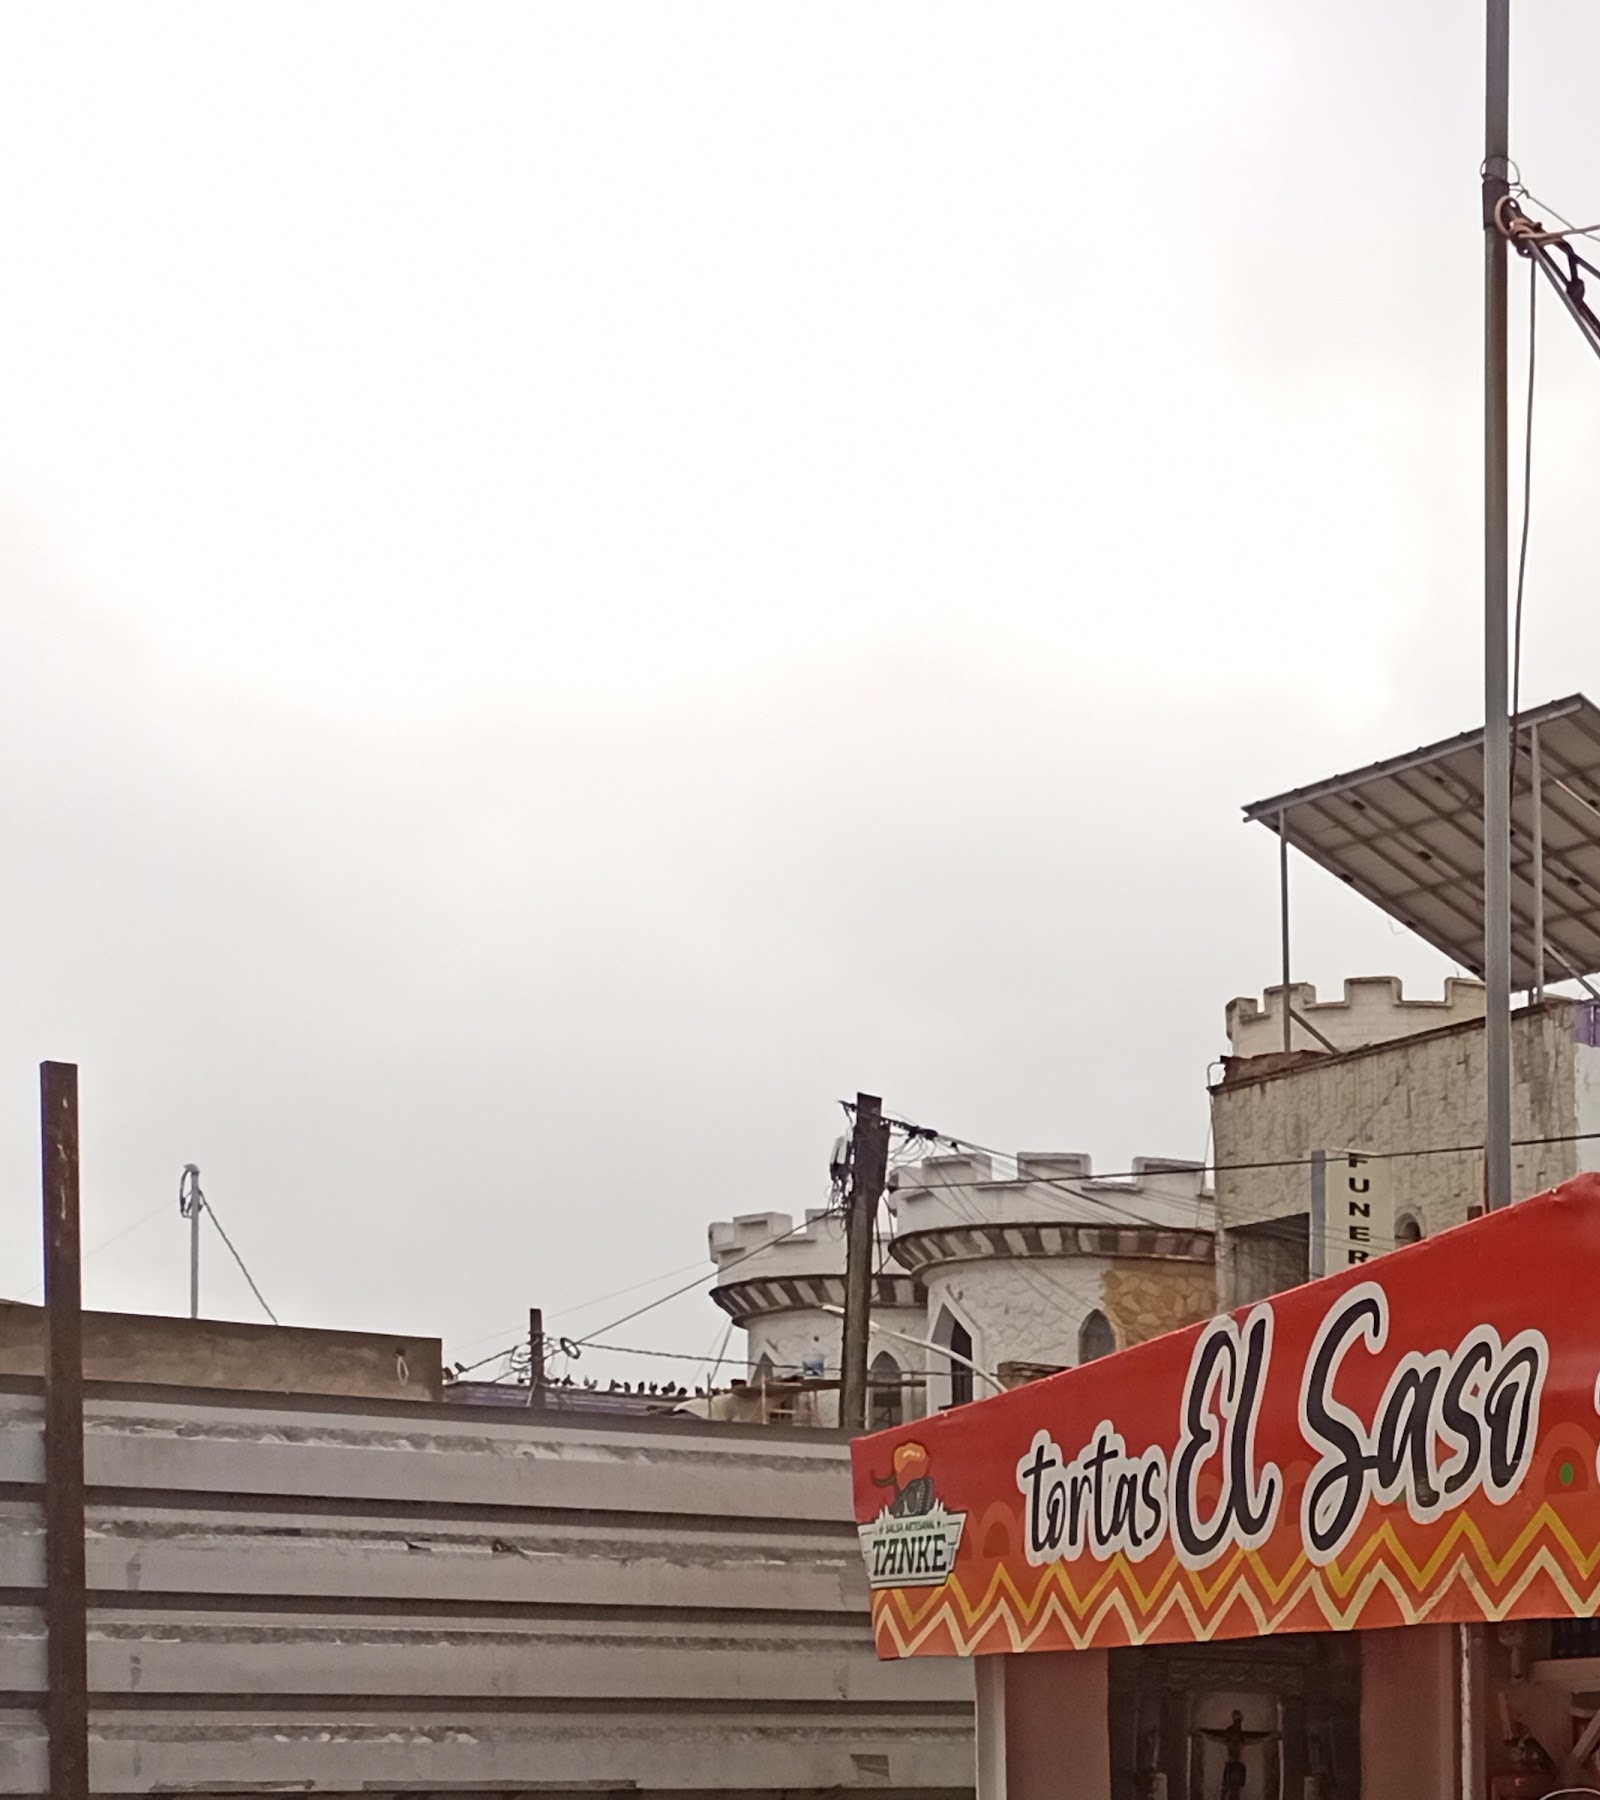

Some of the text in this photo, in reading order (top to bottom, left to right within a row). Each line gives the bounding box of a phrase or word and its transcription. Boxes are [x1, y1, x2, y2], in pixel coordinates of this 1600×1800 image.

[1022, 1297, 1541, 1556] tortas El Saso
[873, 1534, 947, 1576] TANKE
